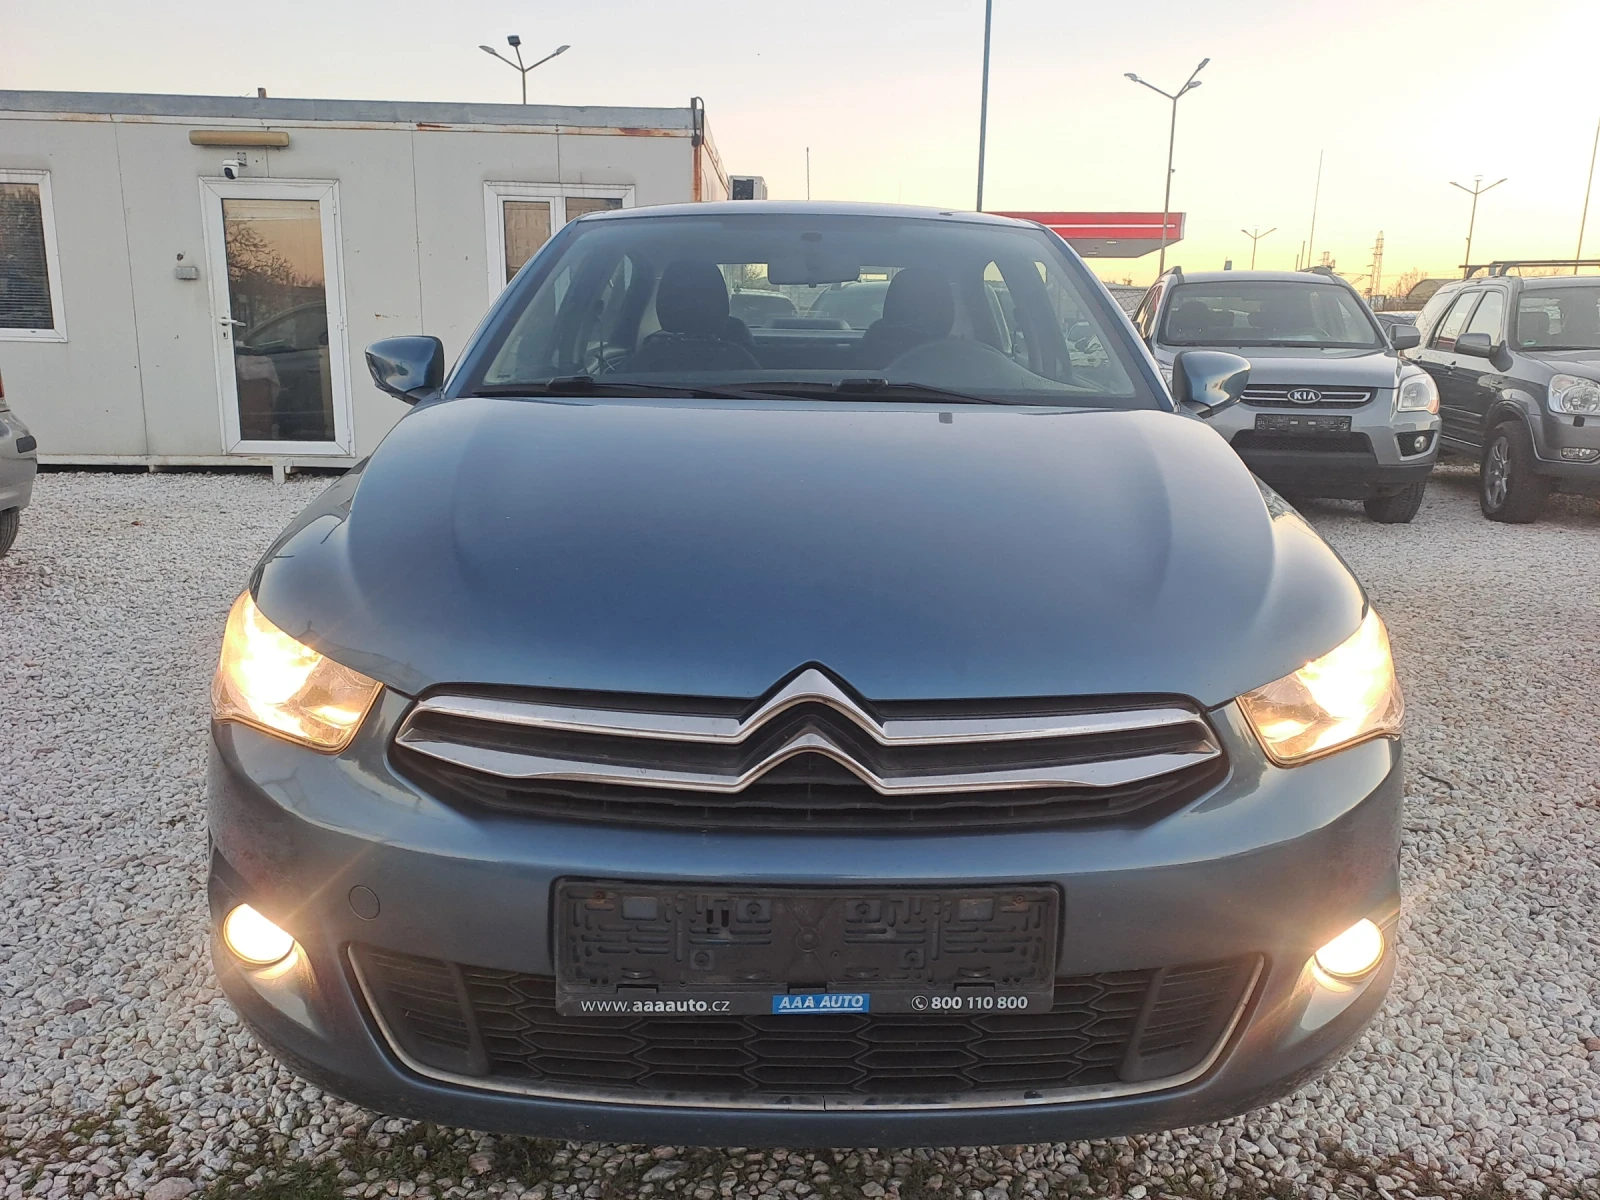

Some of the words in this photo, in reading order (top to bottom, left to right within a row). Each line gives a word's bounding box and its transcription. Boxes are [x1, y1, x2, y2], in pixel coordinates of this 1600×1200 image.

[1293, 391, 1317, 400] KIA
[580, 999, 731, 1013] www.aaaauto.cz
[778, 996, 815, 1009] AAA
[819, 995, 864, 1008] AUTO
[931, 996, 962, 1009] 800
[967, 996, 993, 1009] 110
[997, 996, 1028, 1009] 800
